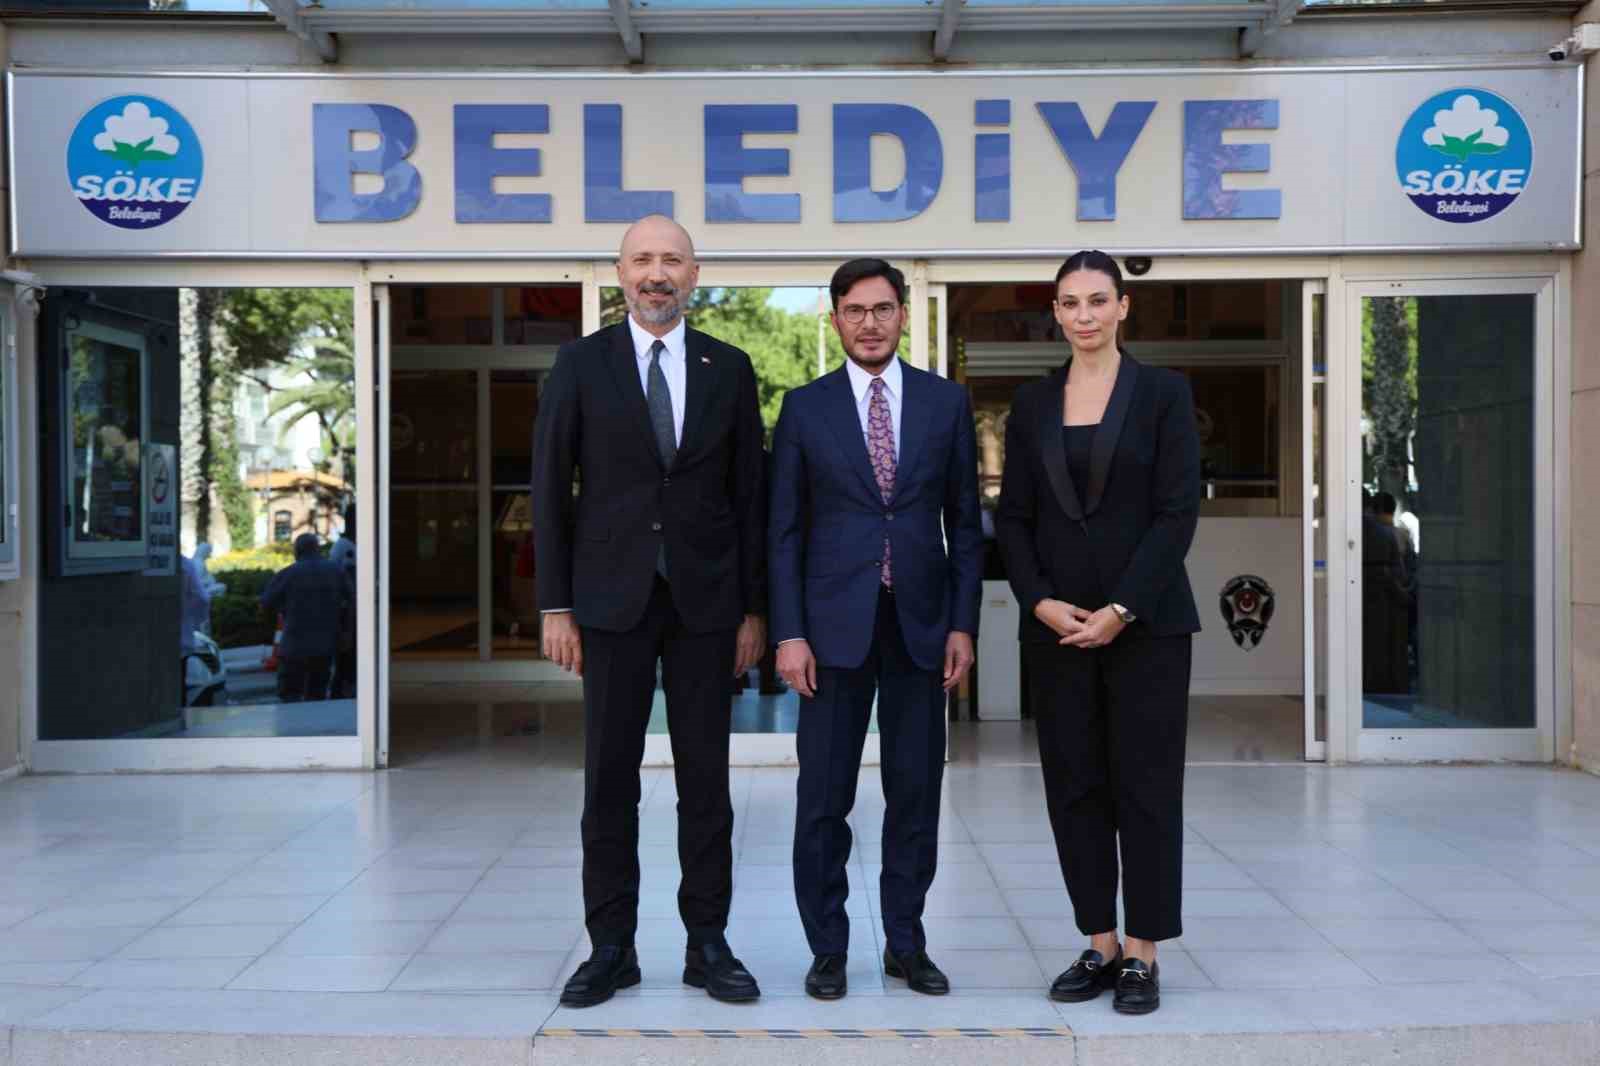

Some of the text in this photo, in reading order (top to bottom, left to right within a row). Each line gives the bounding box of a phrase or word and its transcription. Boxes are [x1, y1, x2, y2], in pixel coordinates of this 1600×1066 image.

[76, 171, 195, 201] SÖKE
[1405, 165, 1525, 195] SÖKE
[110, 206, 162, 222] Belediyesi
[1437, 201, 1488, 216] Belediyesi
